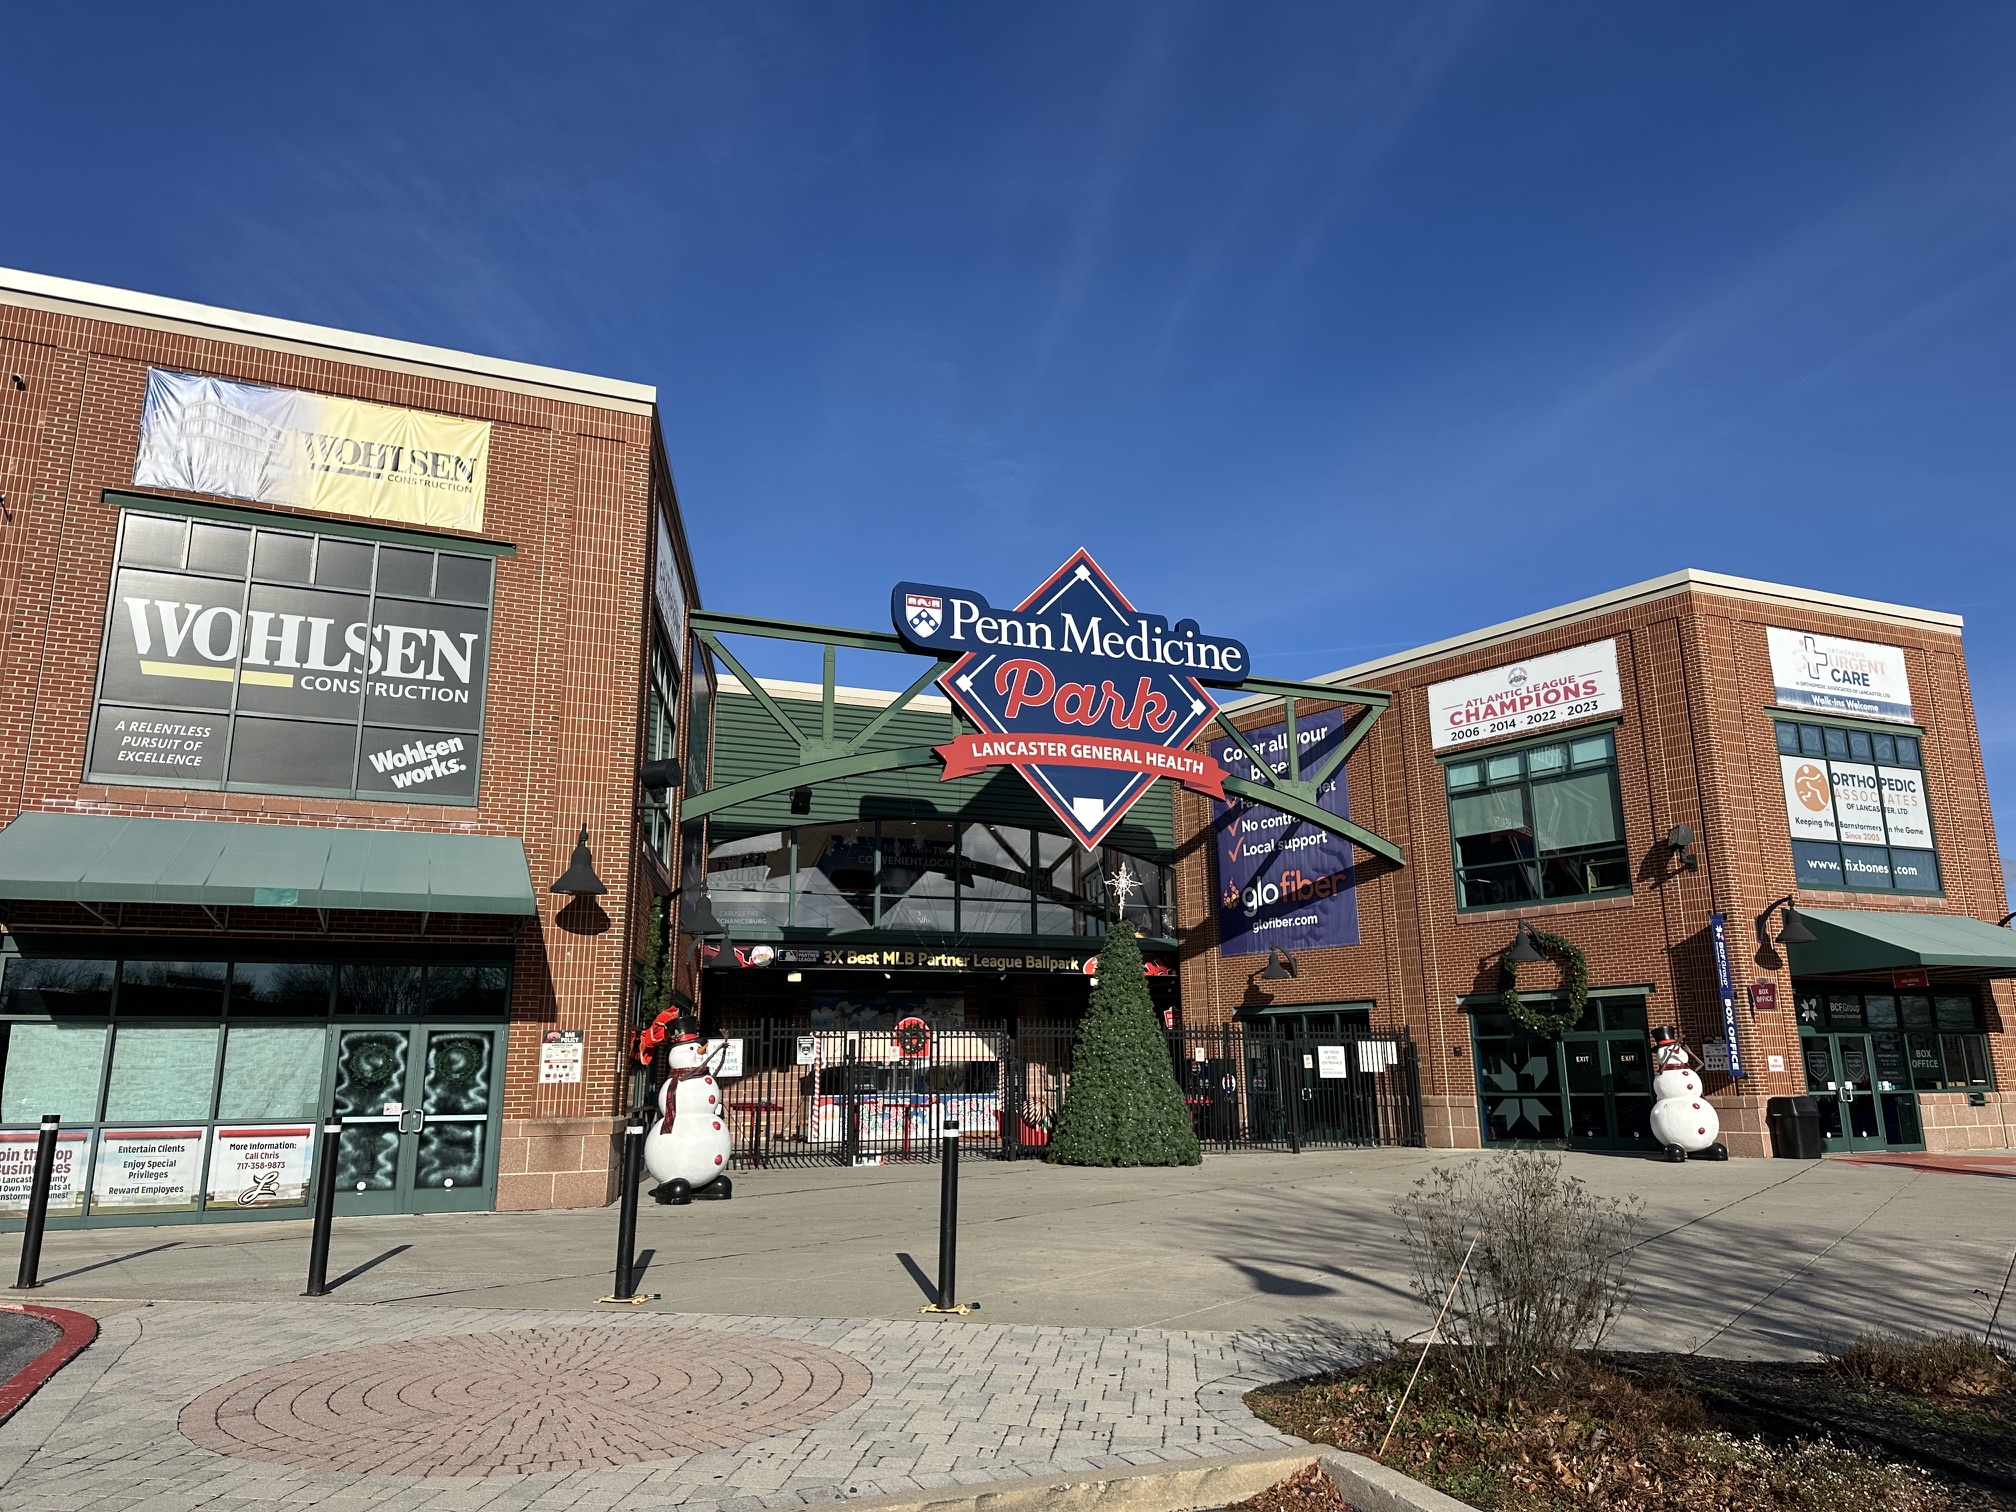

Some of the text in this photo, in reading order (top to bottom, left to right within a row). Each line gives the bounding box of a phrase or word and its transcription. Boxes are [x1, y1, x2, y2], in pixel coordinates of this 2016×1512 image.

[301, 431, 477, 485] WOHLSEN
[387, 473, 473, 494] CONSTRUCTION
[123, 597, 478, 685] WOHLSEN
[949, 598, 1243, 673] Penn Medicine
[1827, 647, 1866, 659] ORTHOPEDIC
[1829, 655, 1886, 676] URGENT
[1831, 669, 1871, 688] CARE
[300, 676, 470, 704] CONSTRUCTION
[995, 658, 1177, 733] Park
[1465, 688, 1523, 709] ATLANTIC
[1526, 675, 1576, 694] LEAGUE
[1449, 679, 1598, 726] CHAMPIONS
[1846, 699, 1879, 712] Welcome
[115, 721, 212, 738] A RELENTLESS
[1451, 700, 1599, 742] 2006 2014 2022 2023
[121, 736, 204, 752] PURSUIT OF
[1269, 733, 1288, 753] all
[117, 750, 203, 767] EXCELLENCE
[369, 737, 464, 773] Wohlsen
[972, 741, 1205, 776] LANCASTER GENERAL HEALTH
[392, 757, 467, 790] works.
[1832, 773, 1917, 793] ORTHOPEDIC
[1835, 789, 1918, 807] ASSOCIATES
[1242, 819, 1259, 833] No
[1795, 817, 1823, 828] Keeping
[1824, 819, 1835, 828] the
[1840, 821, 1882, 832] Barnstormers
[1905, 827, 1924, 836] Game
[1243, 830, 1328, 857] Local support
[1846, 832, 1880, 841] Since 2005
[858, 855, 977, 870] COVENIENT LOCATONS
[1252, 915, 1318, 934] glofiber.com
[824, 950, 1079, 971] 3X Best MLB Partner League Ballpark
[1756, 995, 1773, 1003] OFFICE
[1725, 999, 1740, 1071] BOX OFFICE
[1916, 1050, 1932, 1058] BOX
[1912, 1060, 1939, 1068] OFFICE
[0, 1148, 73, 1163] oin th op
[118, 1144, 185, 1153] Entertain Clients
[229, 1141, 297, 1151] More Information:
[245, 1151, 279, 1160] Call Chris
[123, 1159, 176, 1170] Enjoy Special
[236, 1161, 286, 1170] 717-358-9873
[128, 1170, 169, 1181] Privileges
[109, 1185, 184, 1196] Reward Employees
